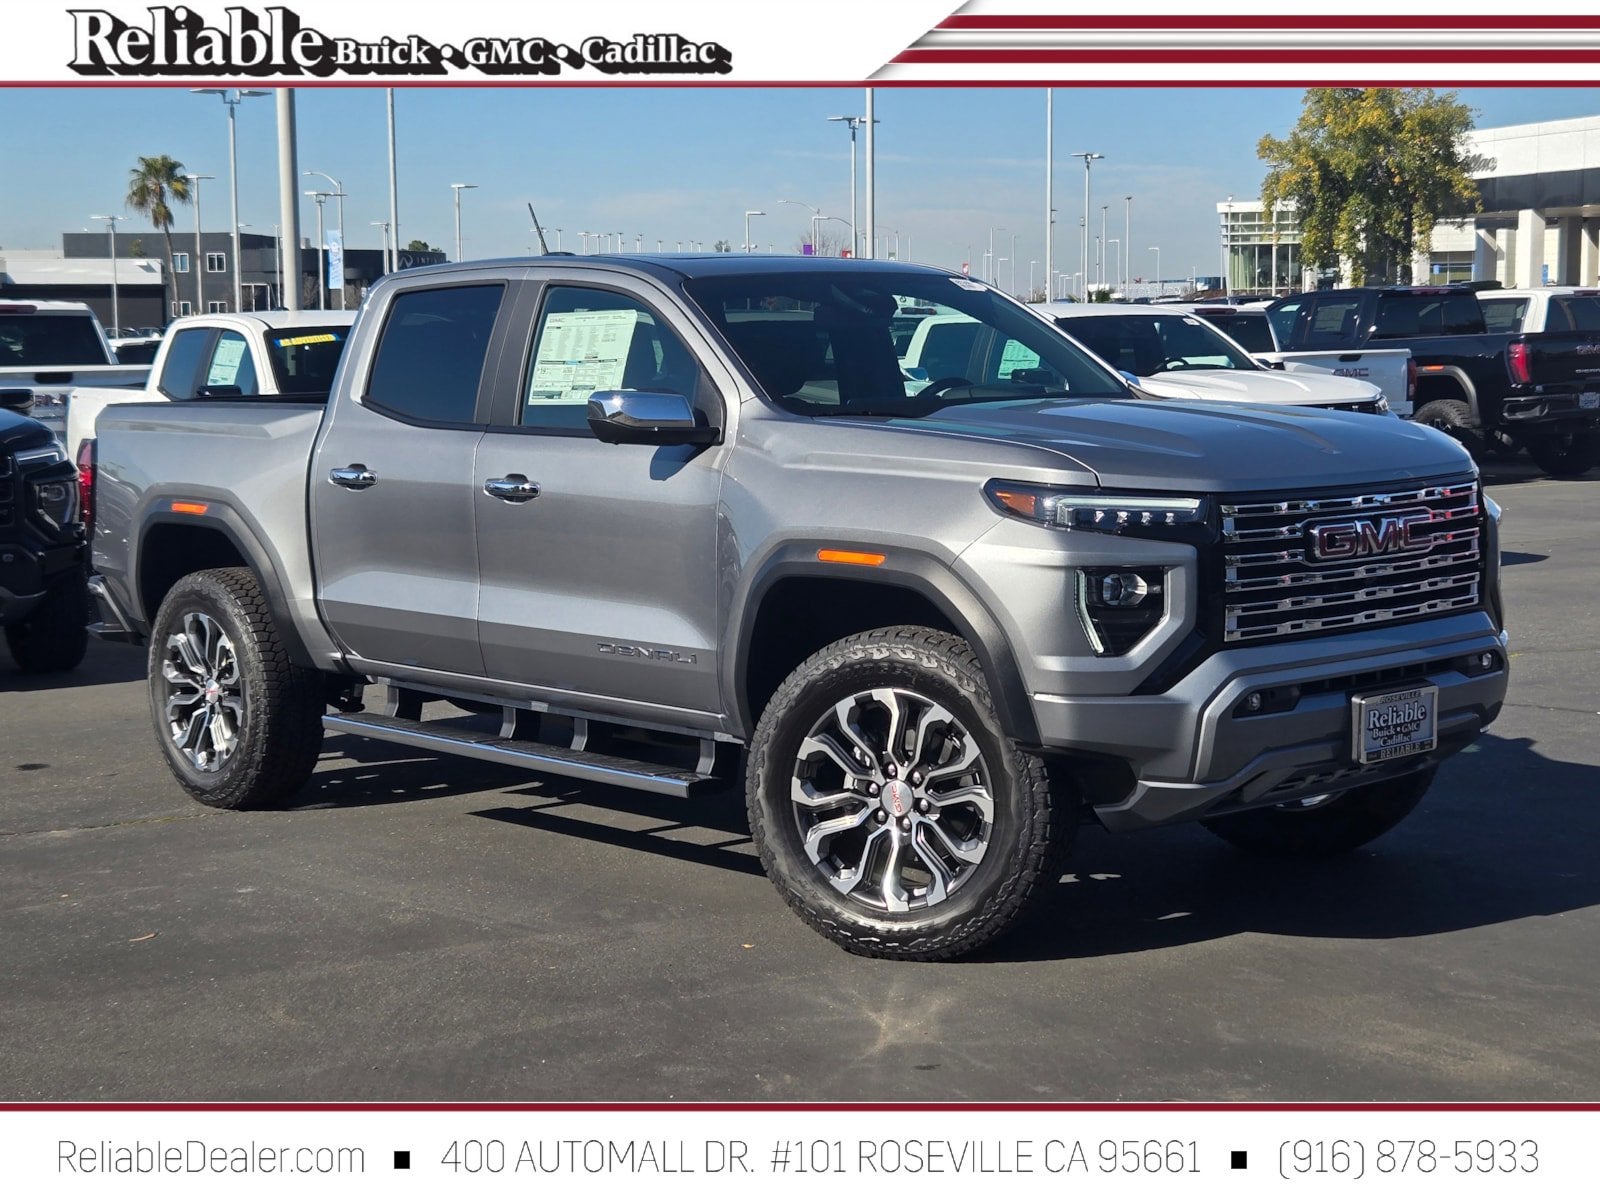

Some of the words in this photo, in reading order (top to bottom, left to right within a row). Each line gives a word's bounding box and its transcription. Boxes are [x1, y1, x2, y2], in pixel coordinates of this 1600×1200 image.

[1333, 368, 1369, 377] GMC
[1312, 514, 1433, 559] GMC
[597, 643, 697, 664] DENALI
[1368, 702, 1426, 729] Reliable
[1372, 726, 1395, 739] Buick
[1401, 721, 1420, 733] GMC
[1380, 735, 1411, 747] Cadillac
[1380, 742, 1421, 759] RELIABLE
[891, 784, 902, 812] GMC
